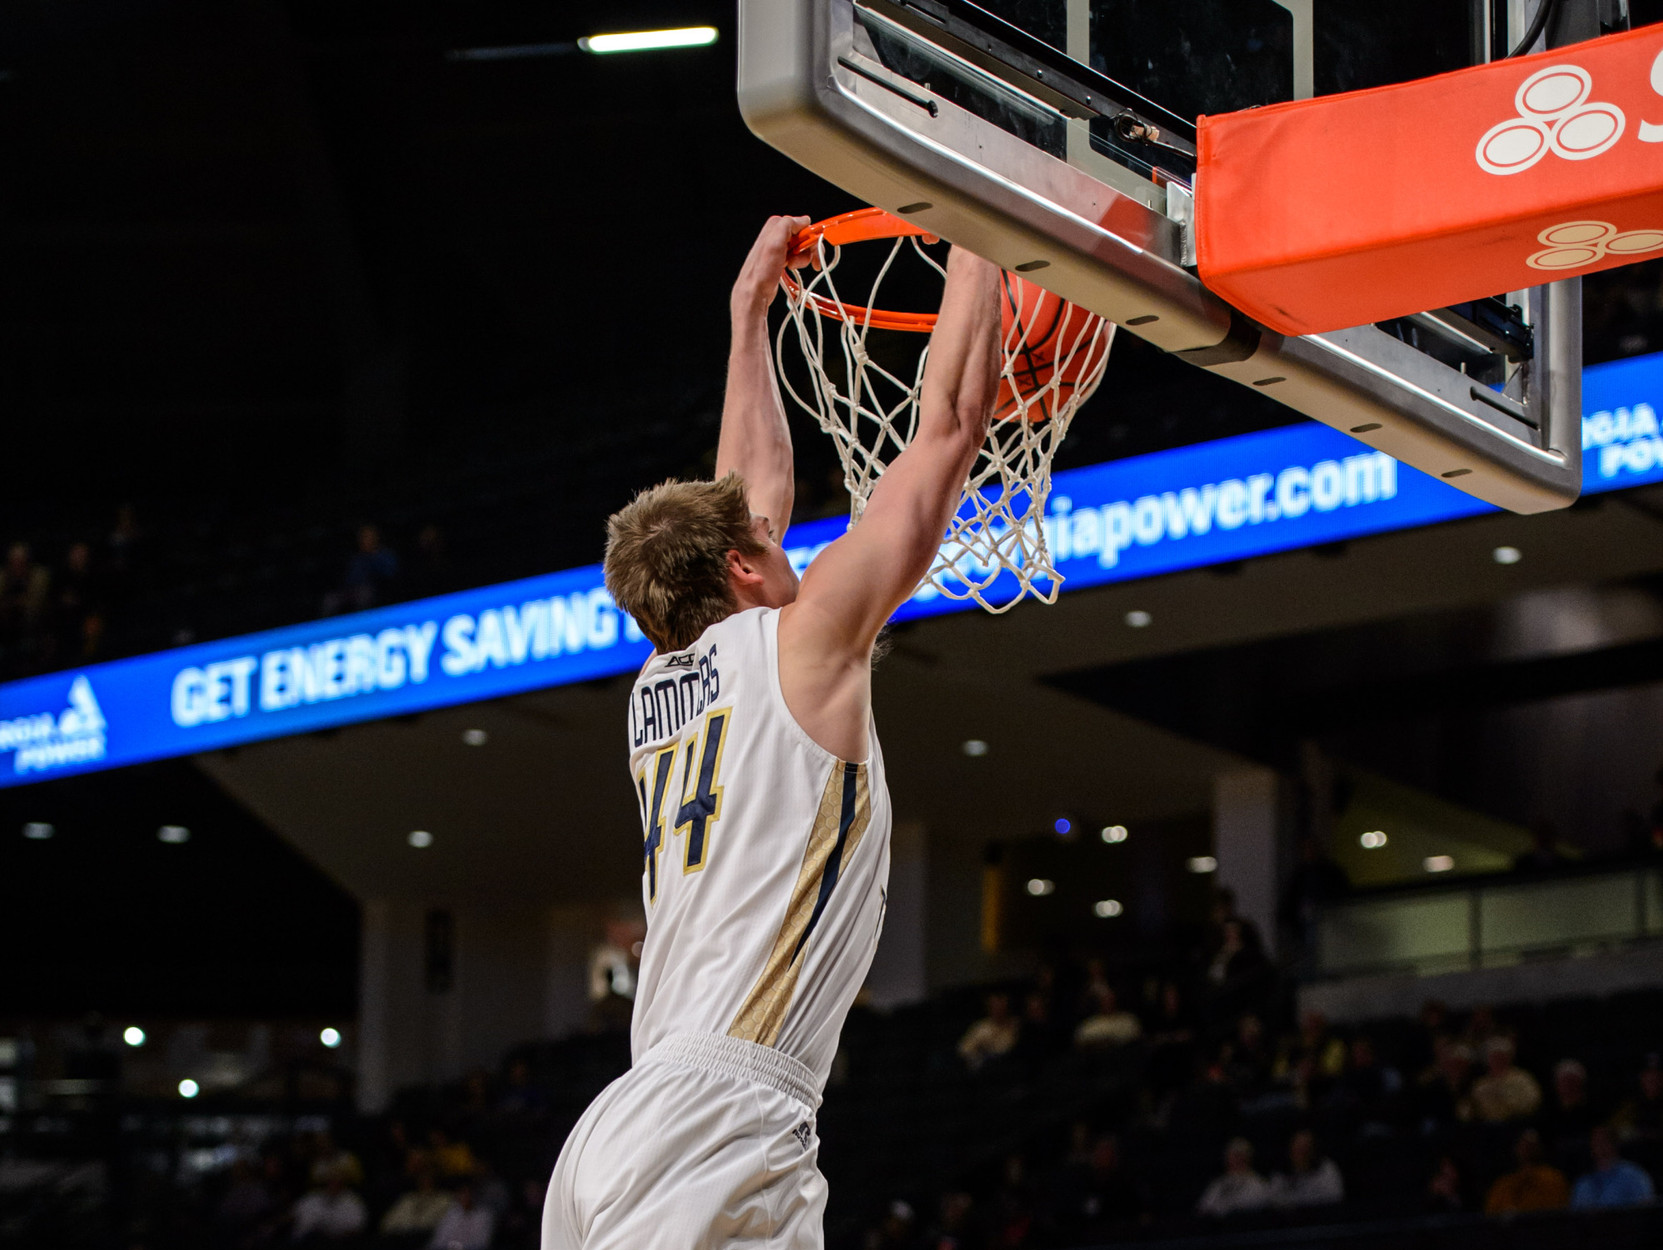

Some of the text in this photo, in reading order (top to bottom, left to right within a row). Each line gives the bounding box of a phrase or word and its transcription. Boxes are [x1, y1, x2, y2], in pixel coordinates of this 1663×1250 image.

[170, 656, 258, 727] GET
[259, 621, 438, 710] ENERGY
[637, 705, 733, 906] 44
